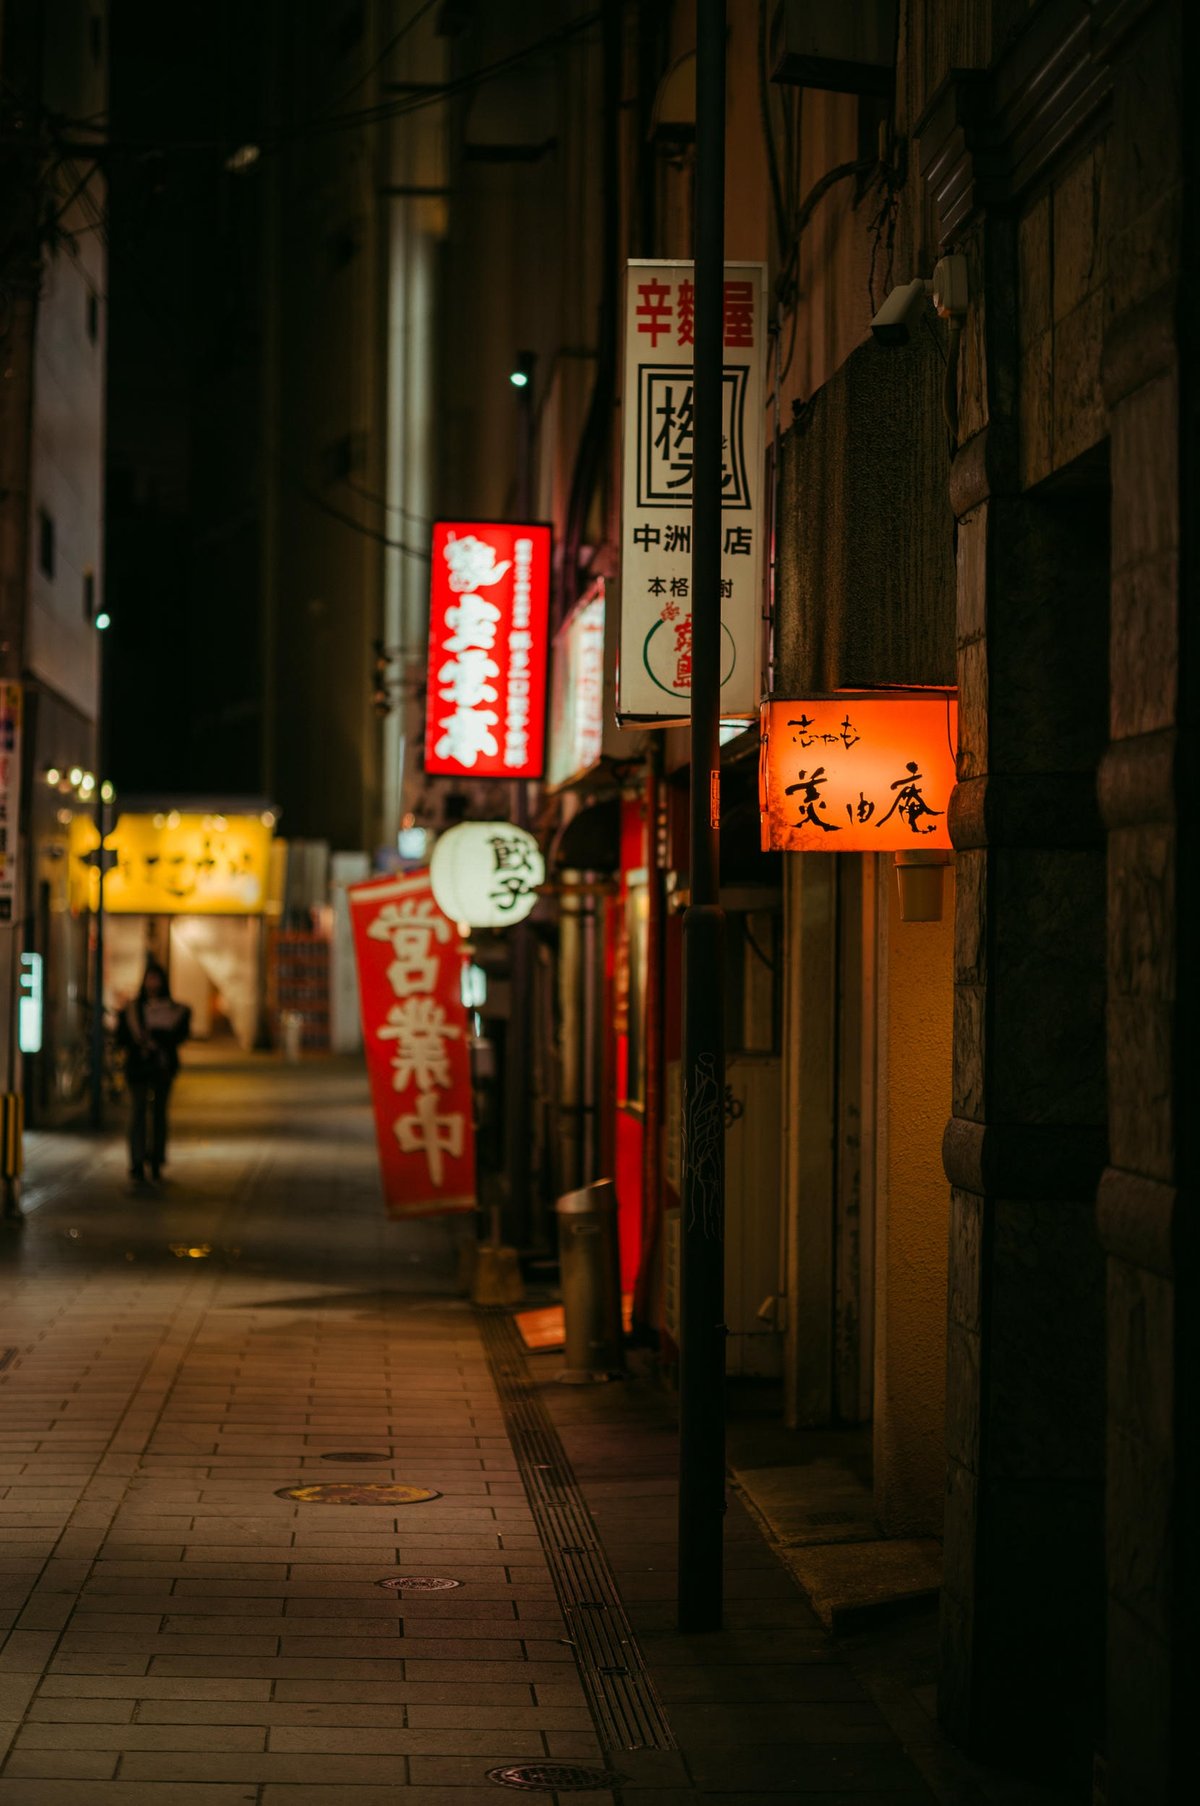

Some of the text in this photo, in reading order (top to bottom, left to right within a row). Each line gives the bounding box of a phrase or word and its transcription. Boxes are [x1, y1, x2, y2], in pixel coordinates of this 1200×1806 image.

[633, 523, 753, 556] 中洲店
[647, 577, 734, 599] 本格酎
[367, 898, 466, 1188] 営業中
